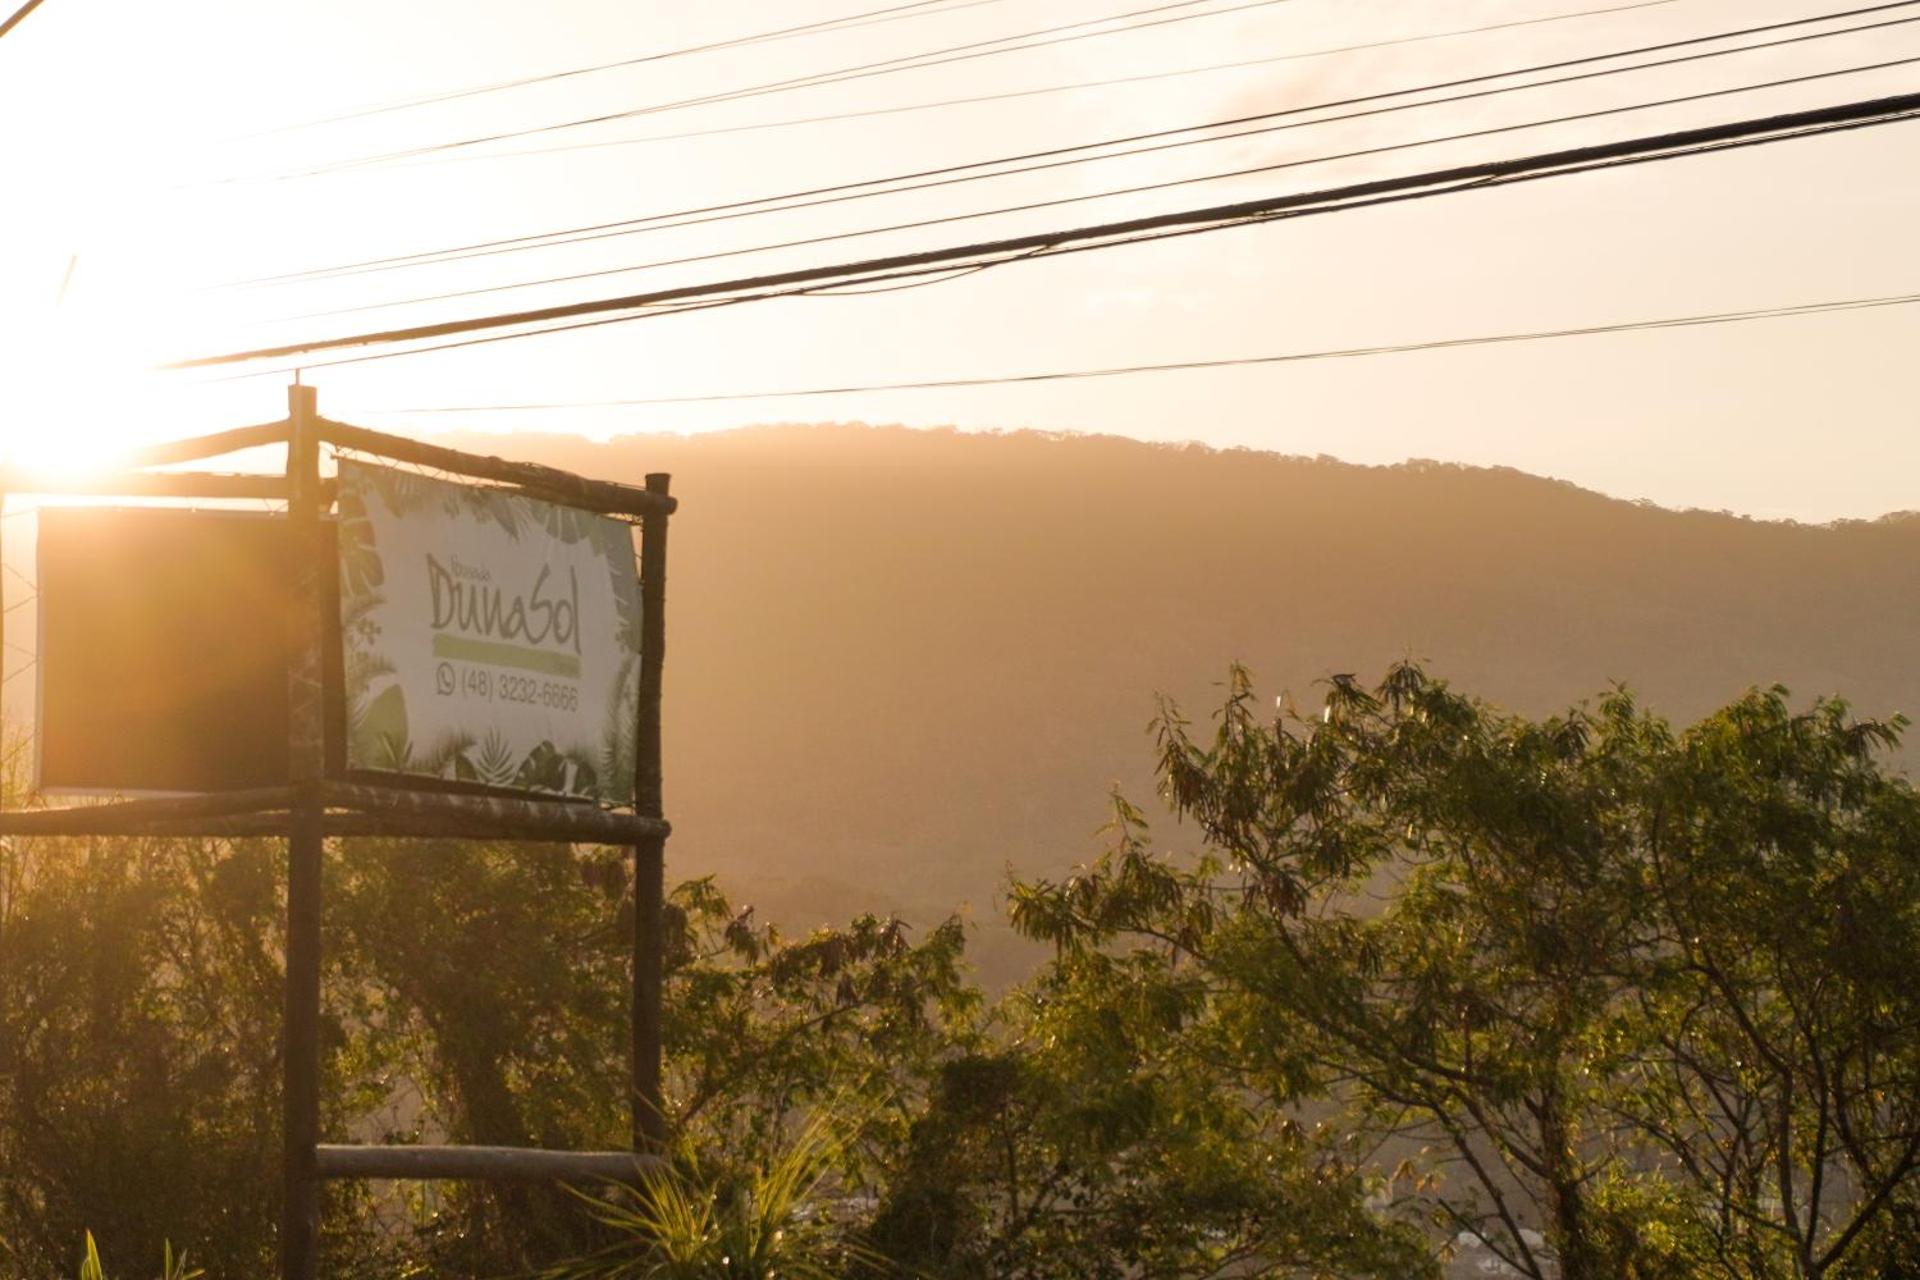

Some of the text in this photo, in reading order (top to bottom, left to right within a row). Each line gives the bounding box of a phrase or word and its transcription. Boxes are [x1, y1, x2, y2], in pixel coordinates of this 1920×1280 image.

[427, 553, 581, 654] DunaSol
[462, 670, 578, 712] (48) 3232-6666
